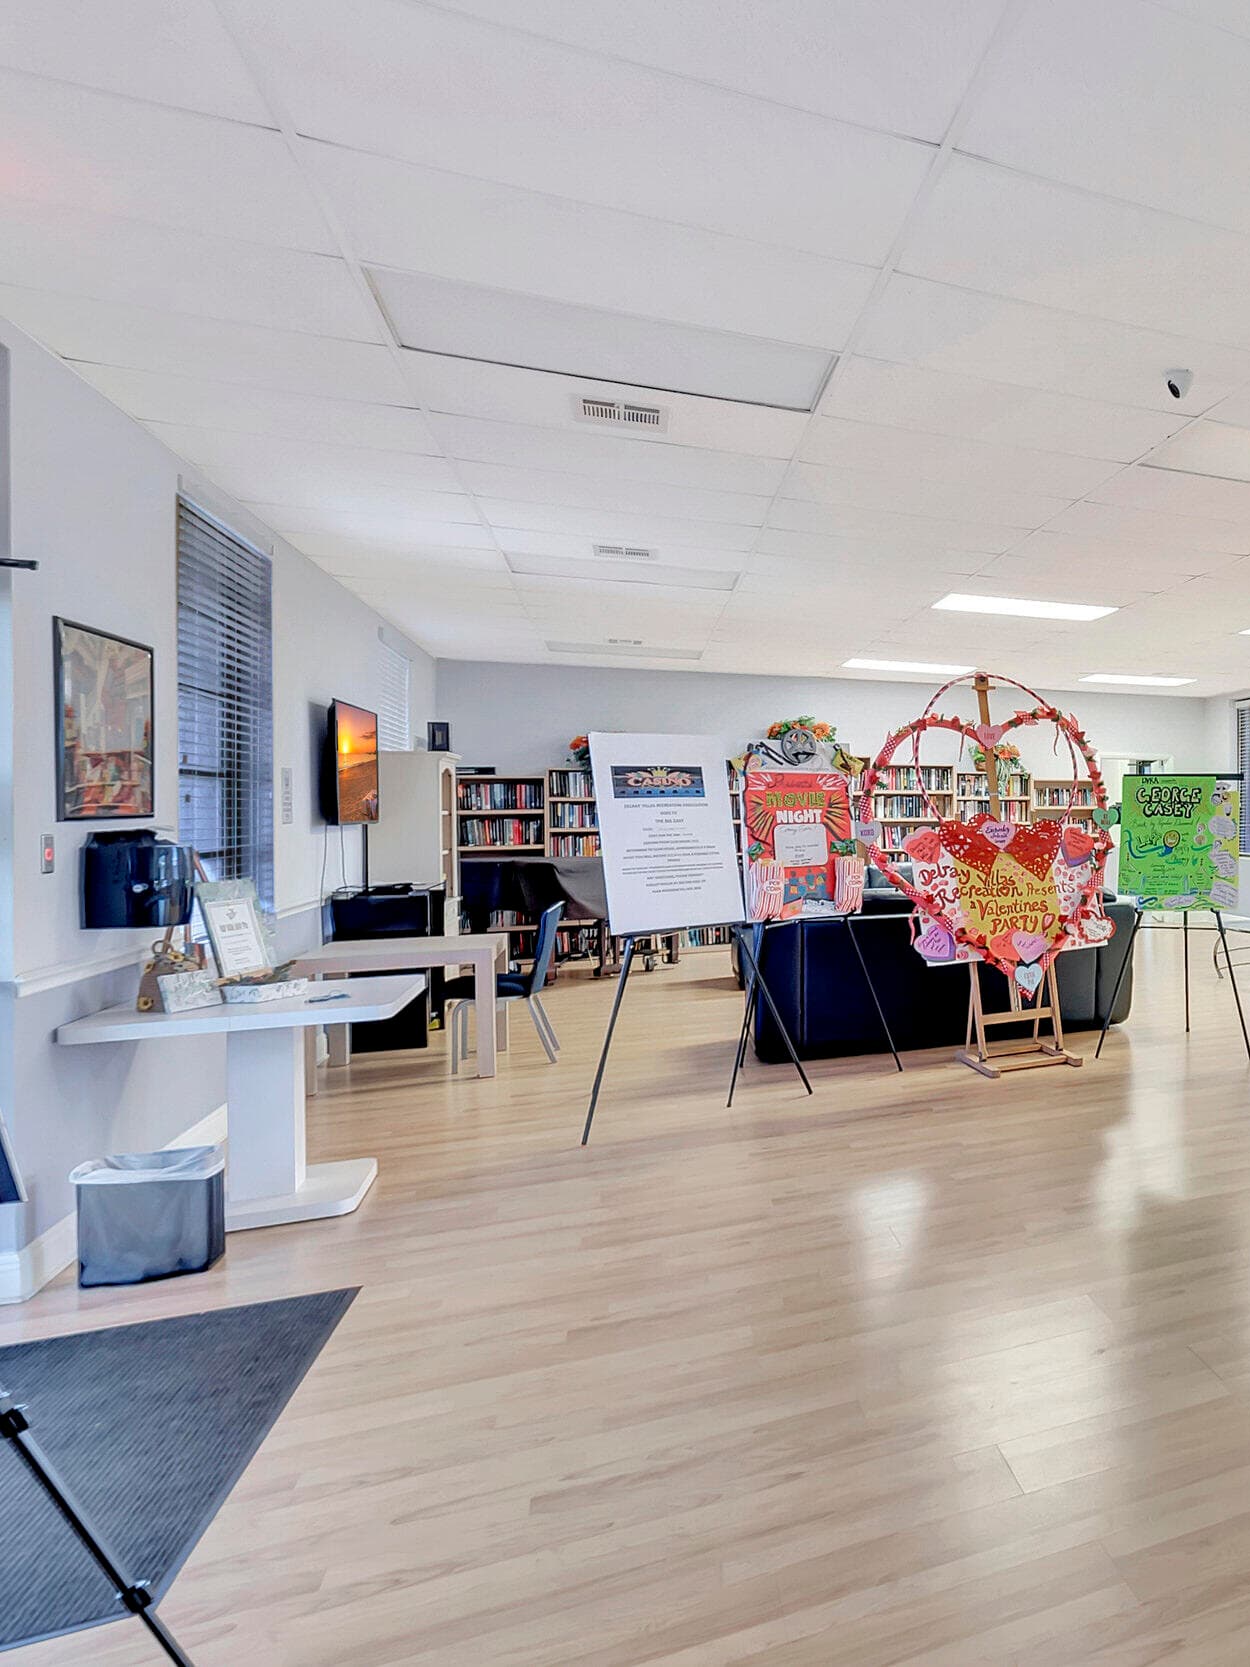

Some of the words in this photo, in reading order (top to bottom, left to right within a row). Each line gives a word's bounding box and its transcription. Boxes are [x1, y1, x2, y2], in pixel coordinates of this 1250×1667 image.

[626, 776, 692, 788] CASINO
[766, 791, 826, 808] MOVIE
[1136, 786, 1202, 804] GEORGE
[776, 809, 822, 823] NIGHT
[1143, 803, 1194, 819] CASEY
[919, 862, 970, 886] Delray
[977, 869, 1016, 888] Villas
[935, 884, 1023, 909] Recreation
[1026, 880, 1075, 897] Presents
[970, 900, 976, 909] a
[976, 899, 1048, 920] Valentines
[990, 914, 1038, 936] PARTY
